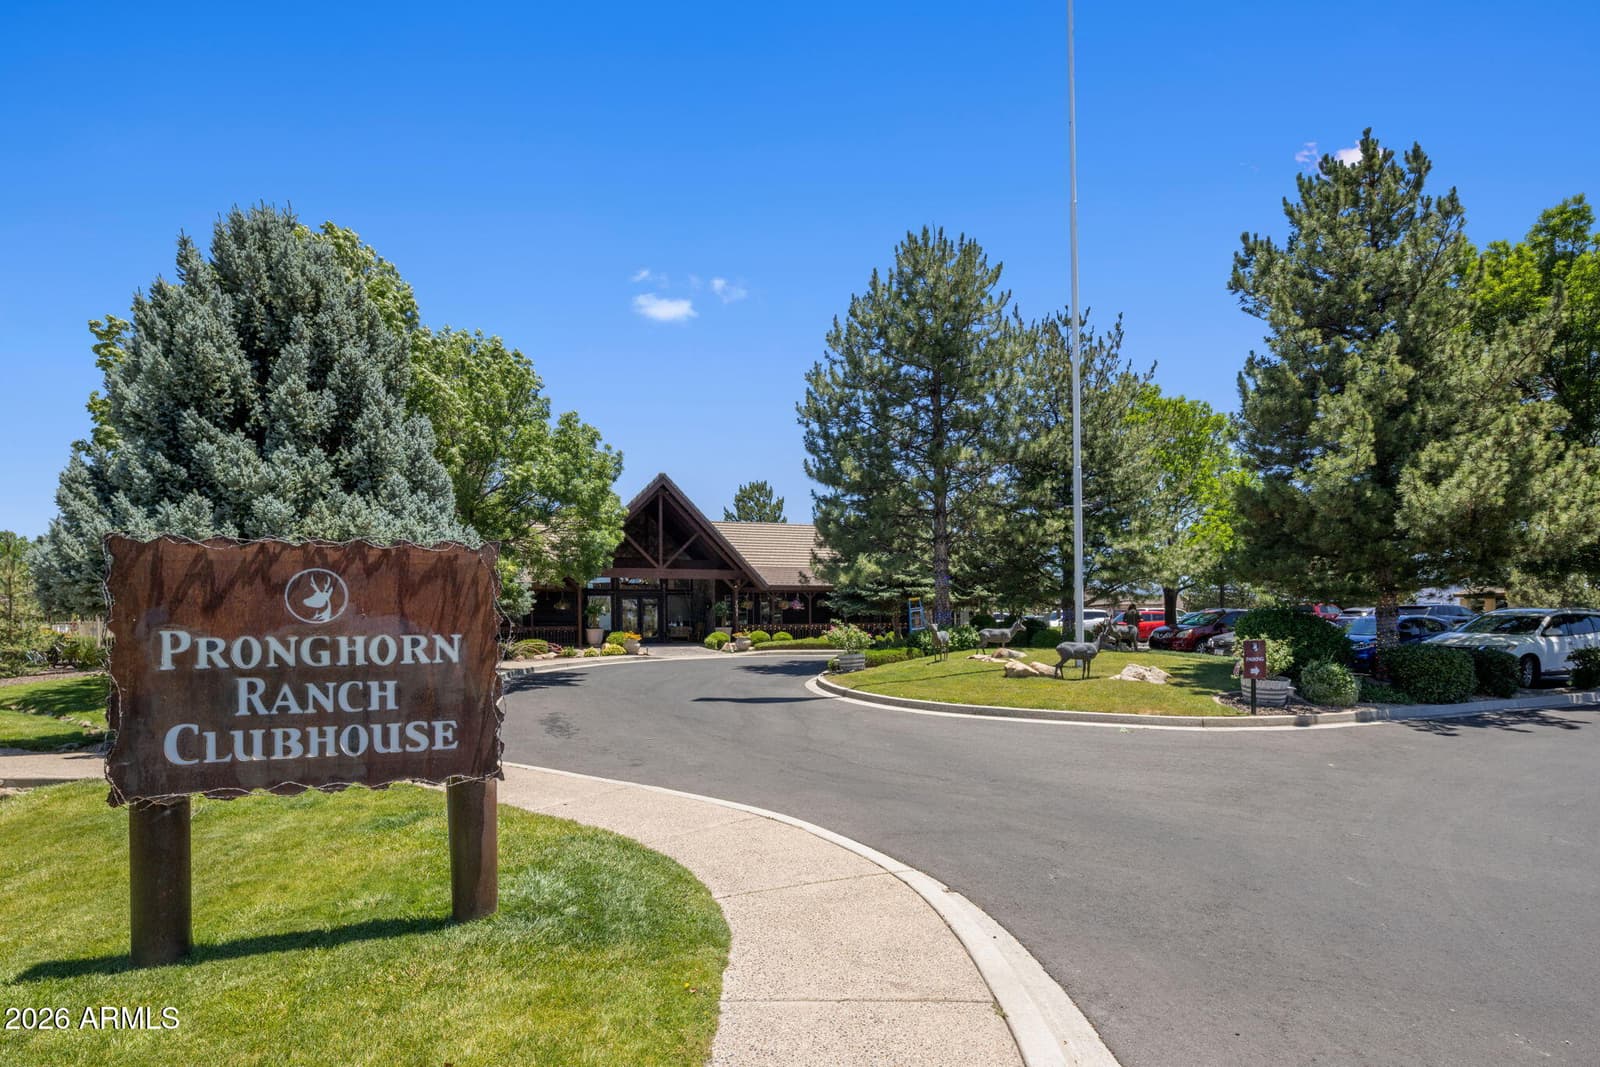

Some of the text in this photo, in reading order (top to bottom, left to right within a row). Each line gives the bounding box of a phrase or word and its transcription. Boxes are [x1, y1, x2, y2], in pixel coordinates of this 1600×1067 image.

[159, 630, 462, 671] PRONGHORN
[234, 677, 399, 717] RANCH
[163, 720, 459, 766] CLUBHOUSE
